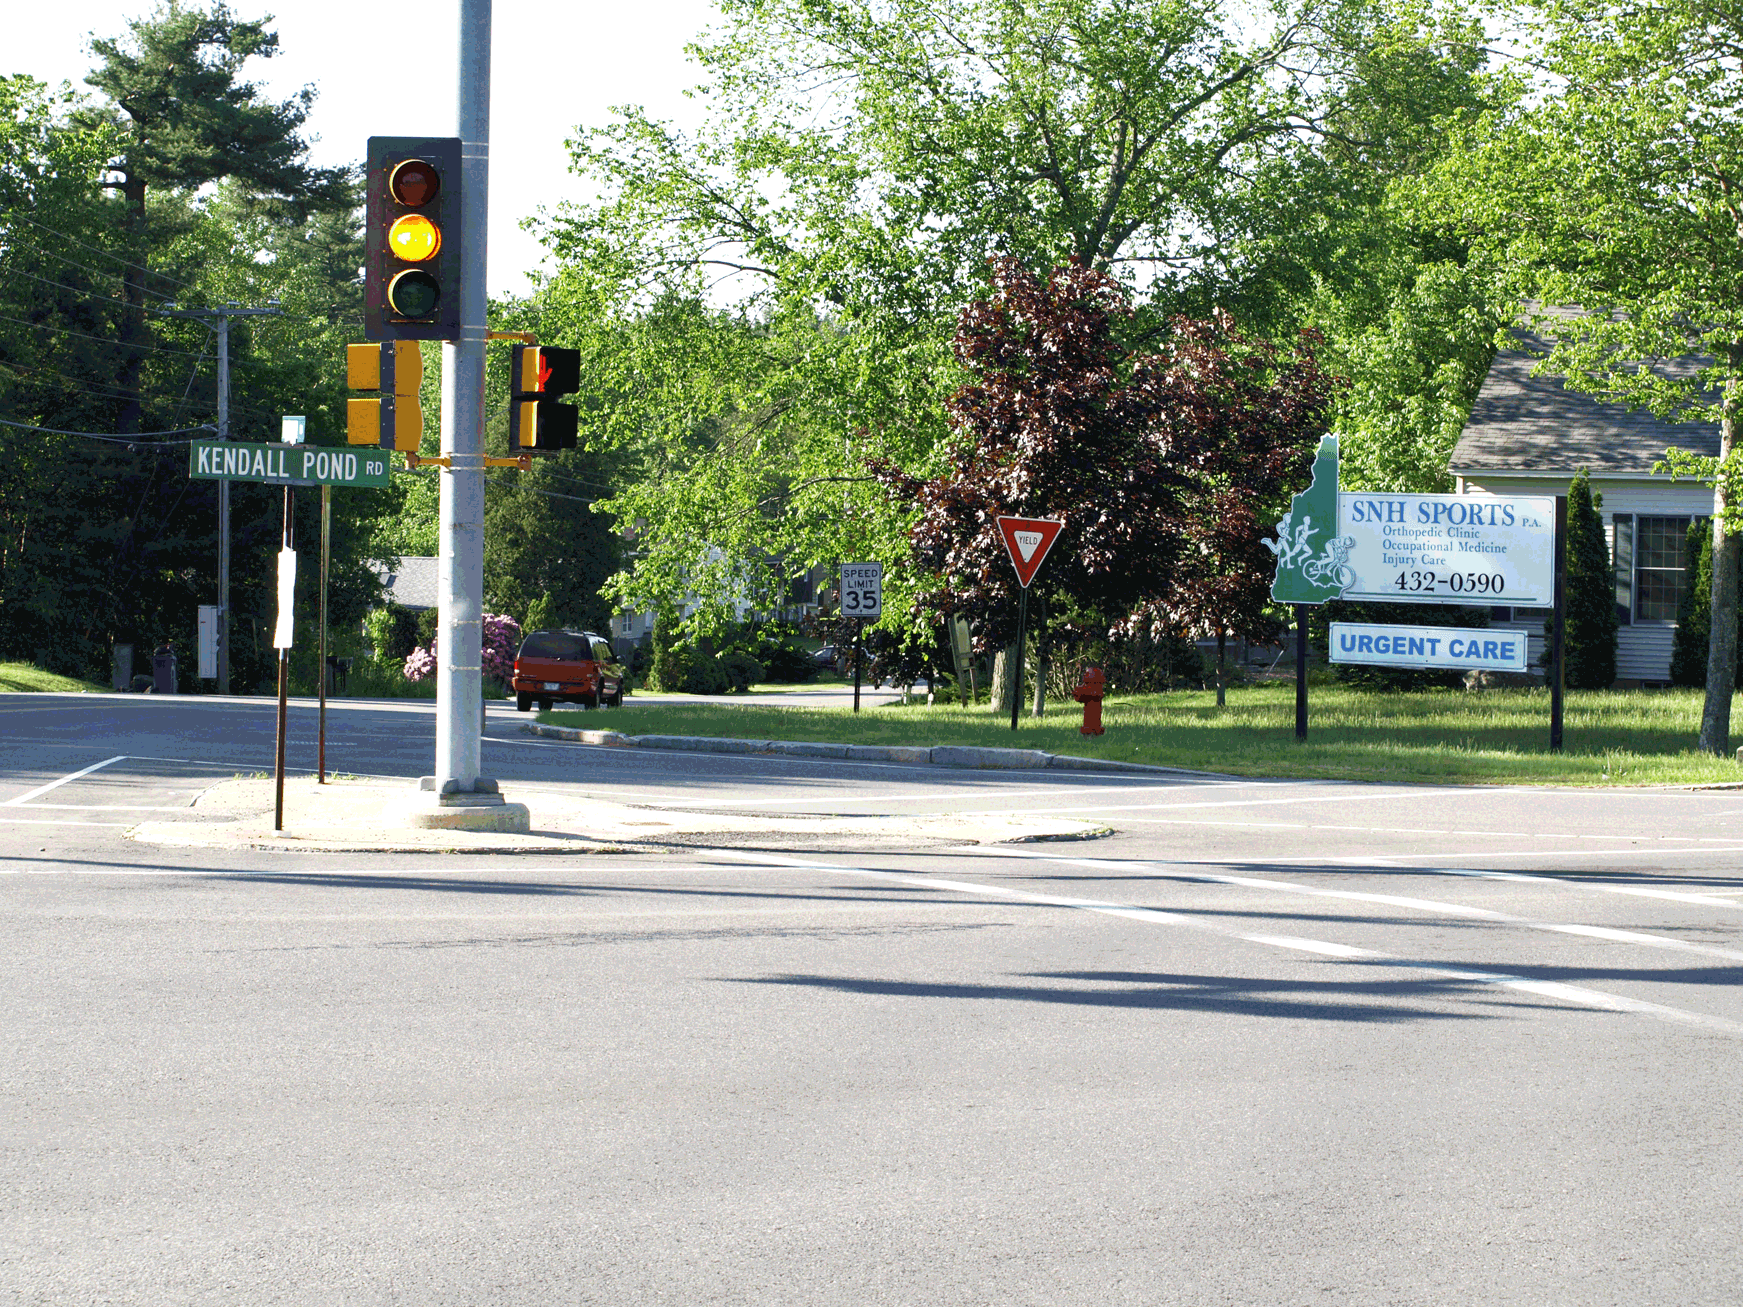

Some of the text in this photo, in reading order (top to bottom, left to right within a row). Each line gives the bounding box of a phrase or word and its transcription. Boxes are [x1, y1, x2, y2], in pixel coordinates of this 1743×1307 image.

[198, 446, 383, 480] KENDALL POND RD
[1352, 500, 1542, 528] SNH SPORTS P.A.
[1019, 535, 1038, 545] YIELD
[1383, 525, 1480, 540] Orthopedic Clinic
[1382, 539, 1507, 554] Occupational Medicine
[1382, 553, 1446, 568] Injury Care
[843, 569, 878, 578] SPEED
[847, 580, 874, 588] LIMIT
[1394, 571, 1505, 594] 432-0590
[846, 591, 877, 610] 35
[1340, 634, 1515, 660] URGENT CARE
